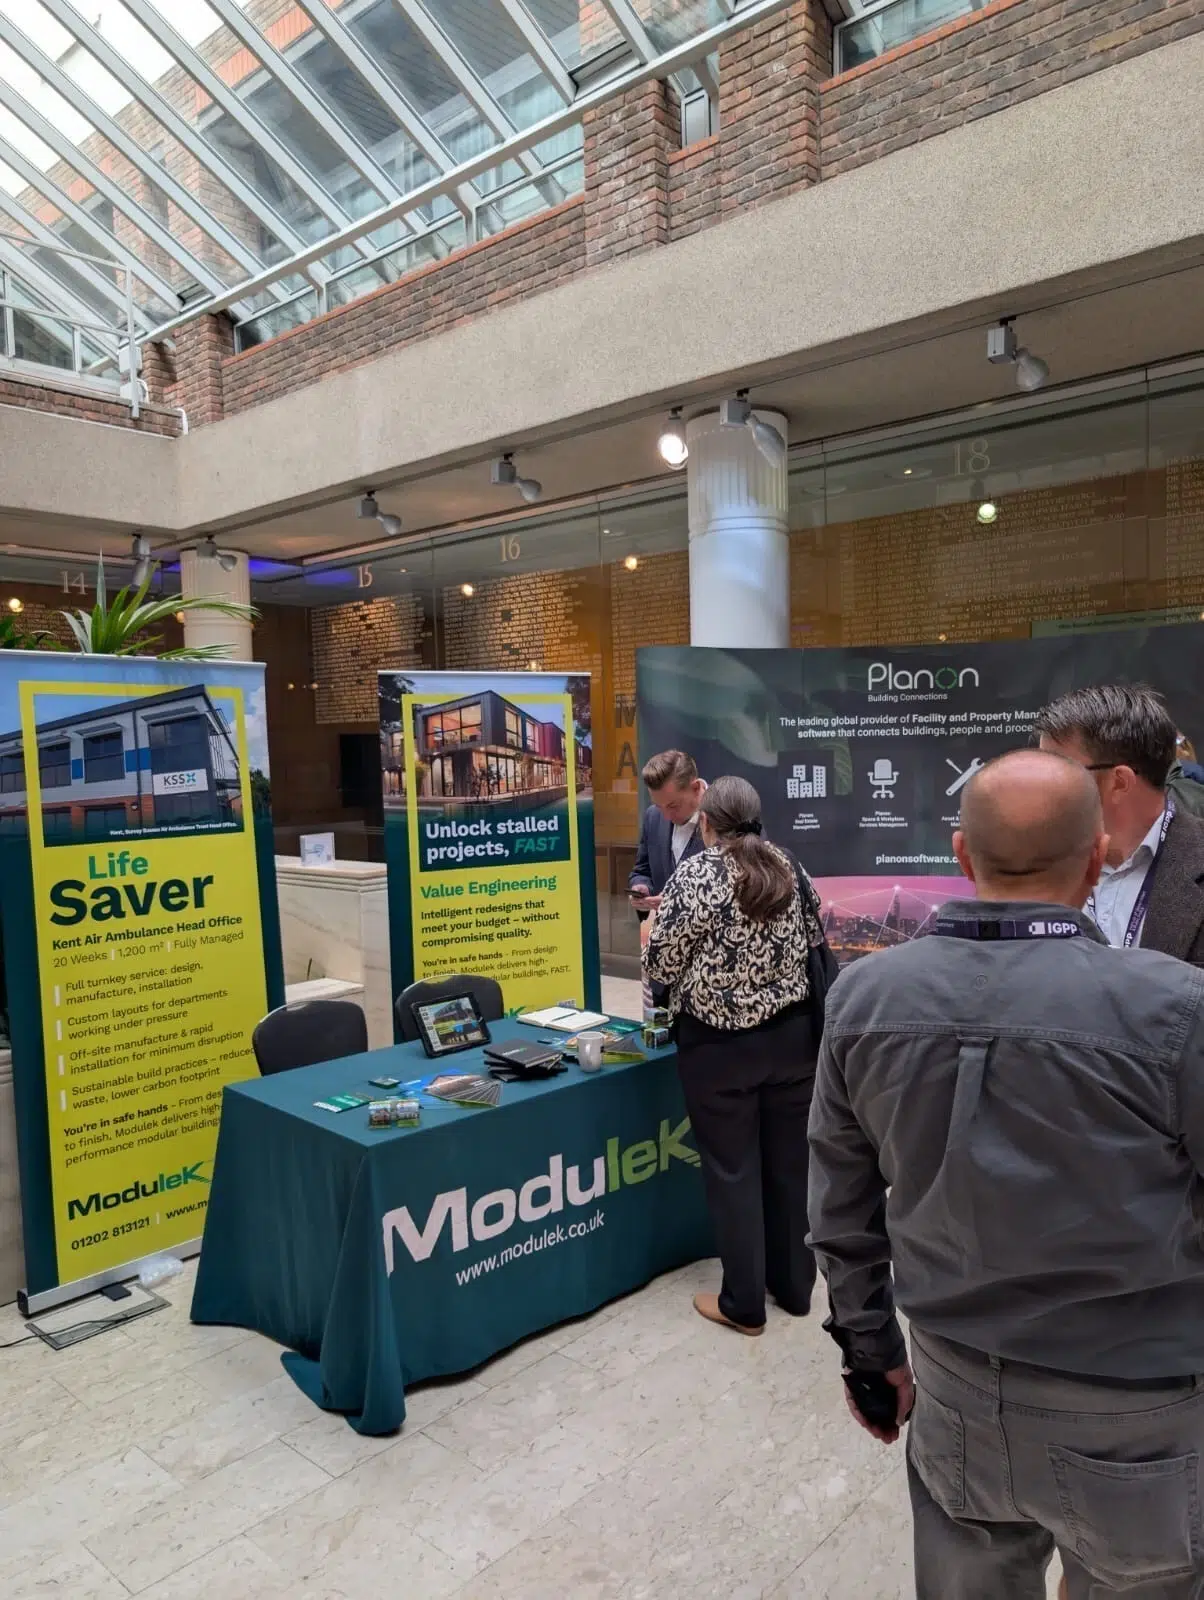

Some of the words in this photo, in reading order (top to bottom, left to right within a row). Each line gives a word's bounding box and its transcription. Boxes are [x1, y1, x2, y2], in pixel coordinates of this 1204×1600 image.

[952, 438, 991, 477] 18
[500, 533, 521, 562] 16
[60, 570, 89, 596] 14
[356, 564, 373, 588] 15
[867, 661, 980, 691] Planon
[867, 693, 899, 703] Building
[899, 692, 948, 702] Connections
[780, 717, 796, 727] The
[798, 716, 829, 729] leading
[830, 716, 858, 728] global
[860, 714, 898, 727] provider
[900, 713, 910, 723] of
[912, 712, 947, 726] Facility
[949, 711, 967, 722] and
[969, 710, 1013, 725] Property
[797, 727, 836, 739] software
[837, 727, 856, 737] that
[857, 726, 900, 737] connects
[902, 725, 948, 738] buildings,
[949, 724, 982, 736] people
[984, 723, 1003, 734] and
[1005, 724, 1033, 735] proce
[425, 818, 492, 840] Unlock
[496, 815, 559, 834] stalled
[426, 842, 510, 865] projects,
[513, 836, 560, 854] FAST
[876, 853, 959, 866] planonsoftware.c
[88, 851, 149, 881] Life
[49, 874, 215, 927] Saver
[420, 883, 464, 900] Value
[468, 875, 557, 898] Engineering
[421, 905, 473, 921] Intelligent
[475, 900, 523, 916] redesigns
[525, 899, 545, 909] that
[421, 922, 448, 934] meet
[450, 919, 473, 933] your
[475, 915, 511, 930] budget
[522, 911, 560, 923] without
[52, 937, 82, 951] Kent
[84, 933, 103, 946] Air
[105, 923, 174, 943] Ambulance
[176, 919, 206, 933] Head
[208, 914, 243, 928] Office
[421, 931, 495, 949] compromising
[496, 927, 533, 942] quality.
[1048, 921, 1078, 935] IGPP
[53, 956, 68, 968] 20
[71, 951, 108, 964] Weeks
[117, 945, 146, 959] 1,200
[173, 936, 198, 950] Fully
[199, 930, 245, 947] Managed
[422, 957, 448, 968] You're
[449, 956, 458, 964] in
[458, 952, 477, 963] safe
[478, 950, 503, 962] hands
[511, 949, 532, 958] From
[533, 944, 558, 955] design
[65, 981, 85, 993] Full
[87, 975, 127, 990] turnkey
[129, 967, 168, 981] service:
[422, 967, 432, 979] to
[460, 963, 495, 974] Modulek
[496, 960, 527, 970] delivers
[528, 957, 549, 968] high-
[512, 968, 549, 981] buildings,
[65, 987, 137, 1006] manufacture,
[138, 975, 193, 992] installation
[67, 1012, 109, 1027] Custom
[111, 1004, 149, 1021] layouts
[152, 1000, 165, 1011] for
[168, 988, 229, 1008] departments
[68, 1024, 111, 1040] working
[113, 1018, 144, 1032] under
[146, 1010, 189, 1027] pressure
[69, 1043, 111, 1061] Off-site
[113, 1032, 179, 1051] manufacture
[180, 1029, 188, 1038] &
[189, 1023, 214, 1038] rapid
[70, 1056, 130, 1075] installation
[132, 1050, 147, 1061] for
[149, 1041, 196, 1058] minimum
[197, 1030, 245, 1048] disruption
[71, 1074, 135, 1096] Sustainable
[136, 1066, 163, 1081] build
[164, 1056, 209, 1076] practices
[72, 1095, 108, 1111] waste,
[111, 1086, 140, 1101] lower
[142, 1078, 177, 1095] carbon
[179, 1066, 221, 1085] footprint
[99, 1119, 111, 1129] in
[112, 1113, 135, 1126] safe
[137, 1103, 169, 1118] hands
[178, 1096, 204, 1108] From
[205, 1089, 223, 1101] des
[64, 1142, 76, 1152] to
[79, 1133, 113, 1148] finish,
[115, 1122, 159, 1139] Modulek
[161, 1109, 199, 1126] delivers
[65, 1140, 135, 1168] performance
[137, 1127, 178, 1146] modular
[71, 1230, 109, 1251] 01202
[112, 1216, 151, 1238] 813121
[166, 1199, 208, 1219] www.m
[455, 1209, 606, 1287] www.modulek.co.uk
